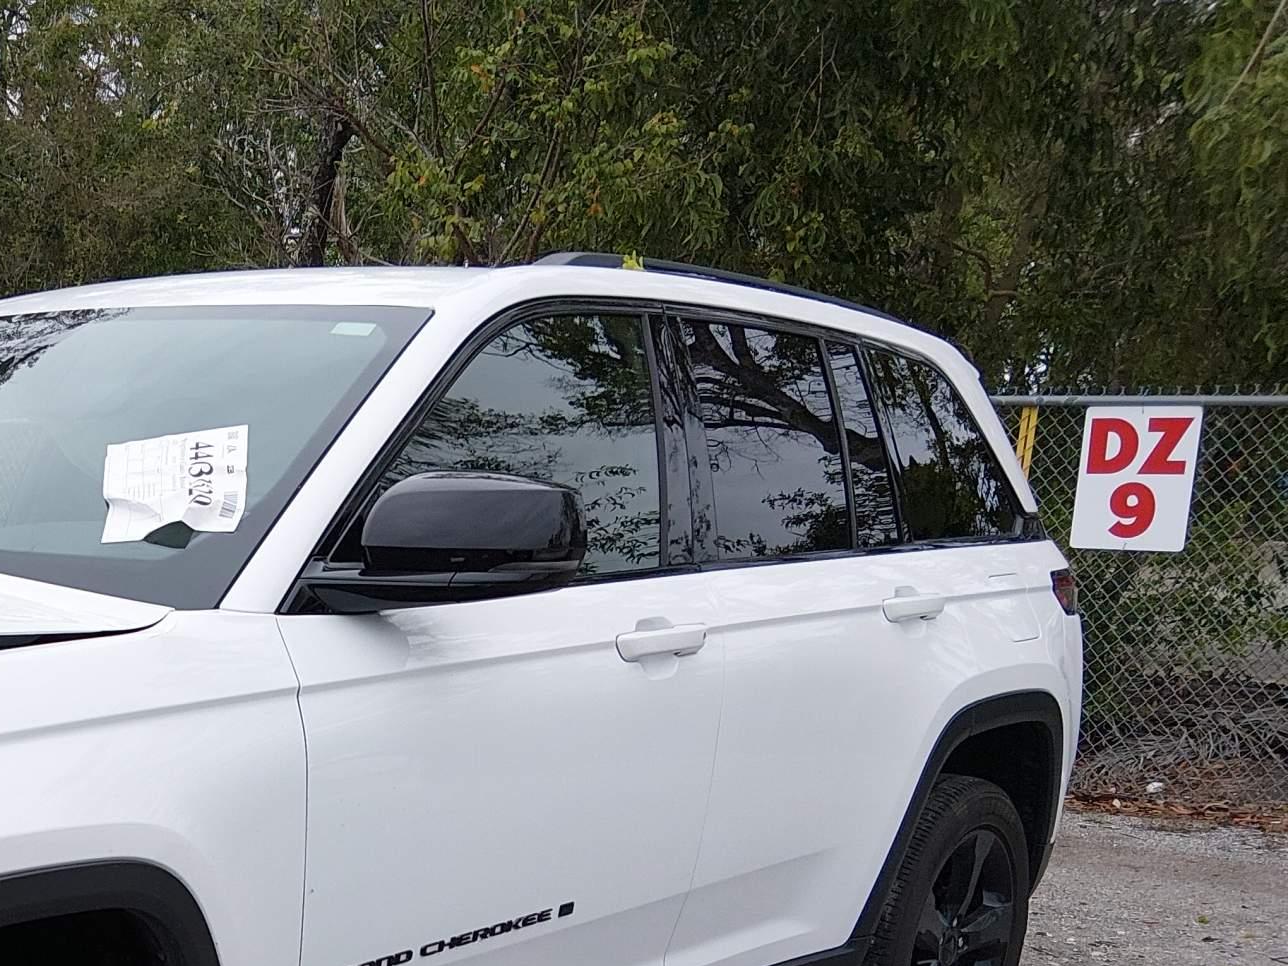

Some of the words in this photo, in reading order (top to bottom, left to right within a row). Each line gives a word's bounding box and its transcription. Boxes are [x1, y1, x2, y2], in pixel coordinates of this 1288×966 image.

[1086, 418, 1196, 475] DZ
[1108, 481, 1156, 539] 9
[419, 908, 554, 957] CHEROKEE
